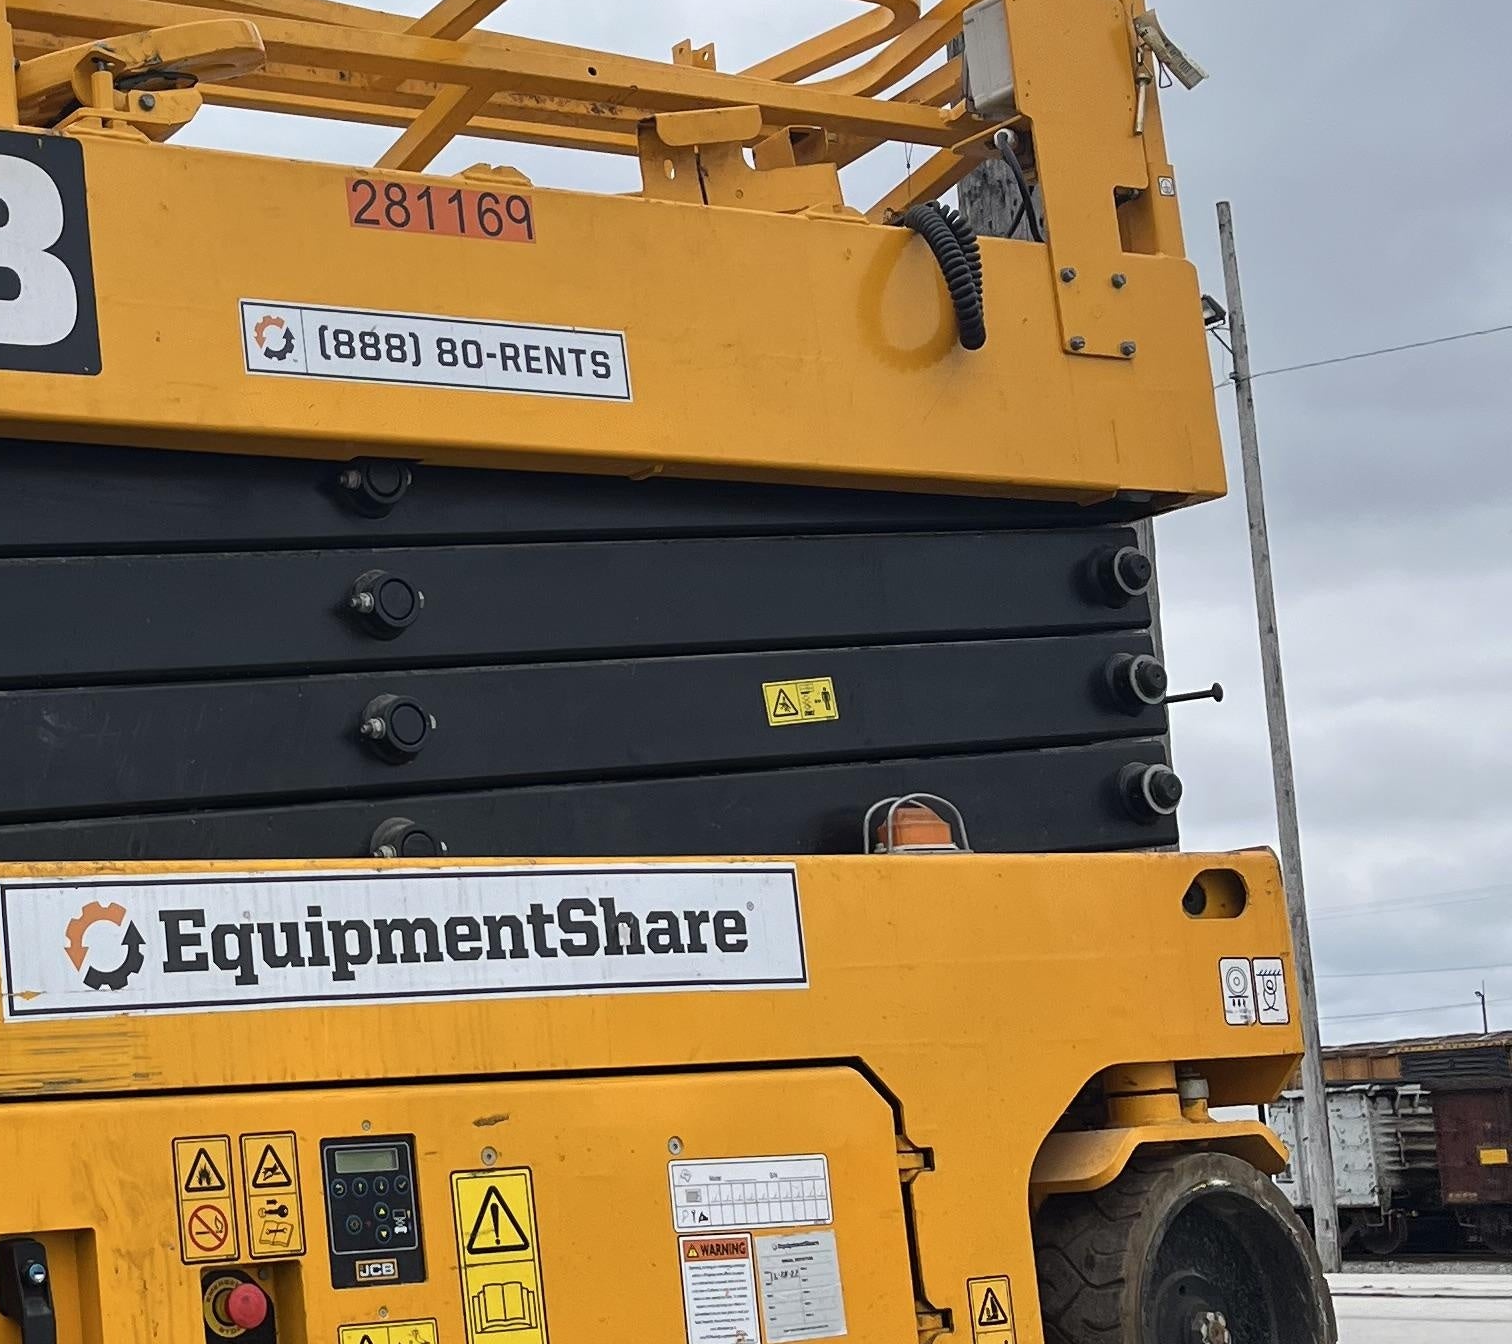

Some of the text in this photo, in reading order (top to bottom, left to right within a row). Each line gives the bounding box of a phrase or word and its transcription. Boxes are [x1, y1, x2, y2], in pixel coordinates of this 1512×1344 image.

[351, 178, 534, 241] 281169
[317, 324, 612, 380] (888) 80-RENTS
[159, 897, 750, 985] EquipmentShare
[359, 1262, 395, 1277] JCB
[700, 1242, 747, 1256] WARNING
